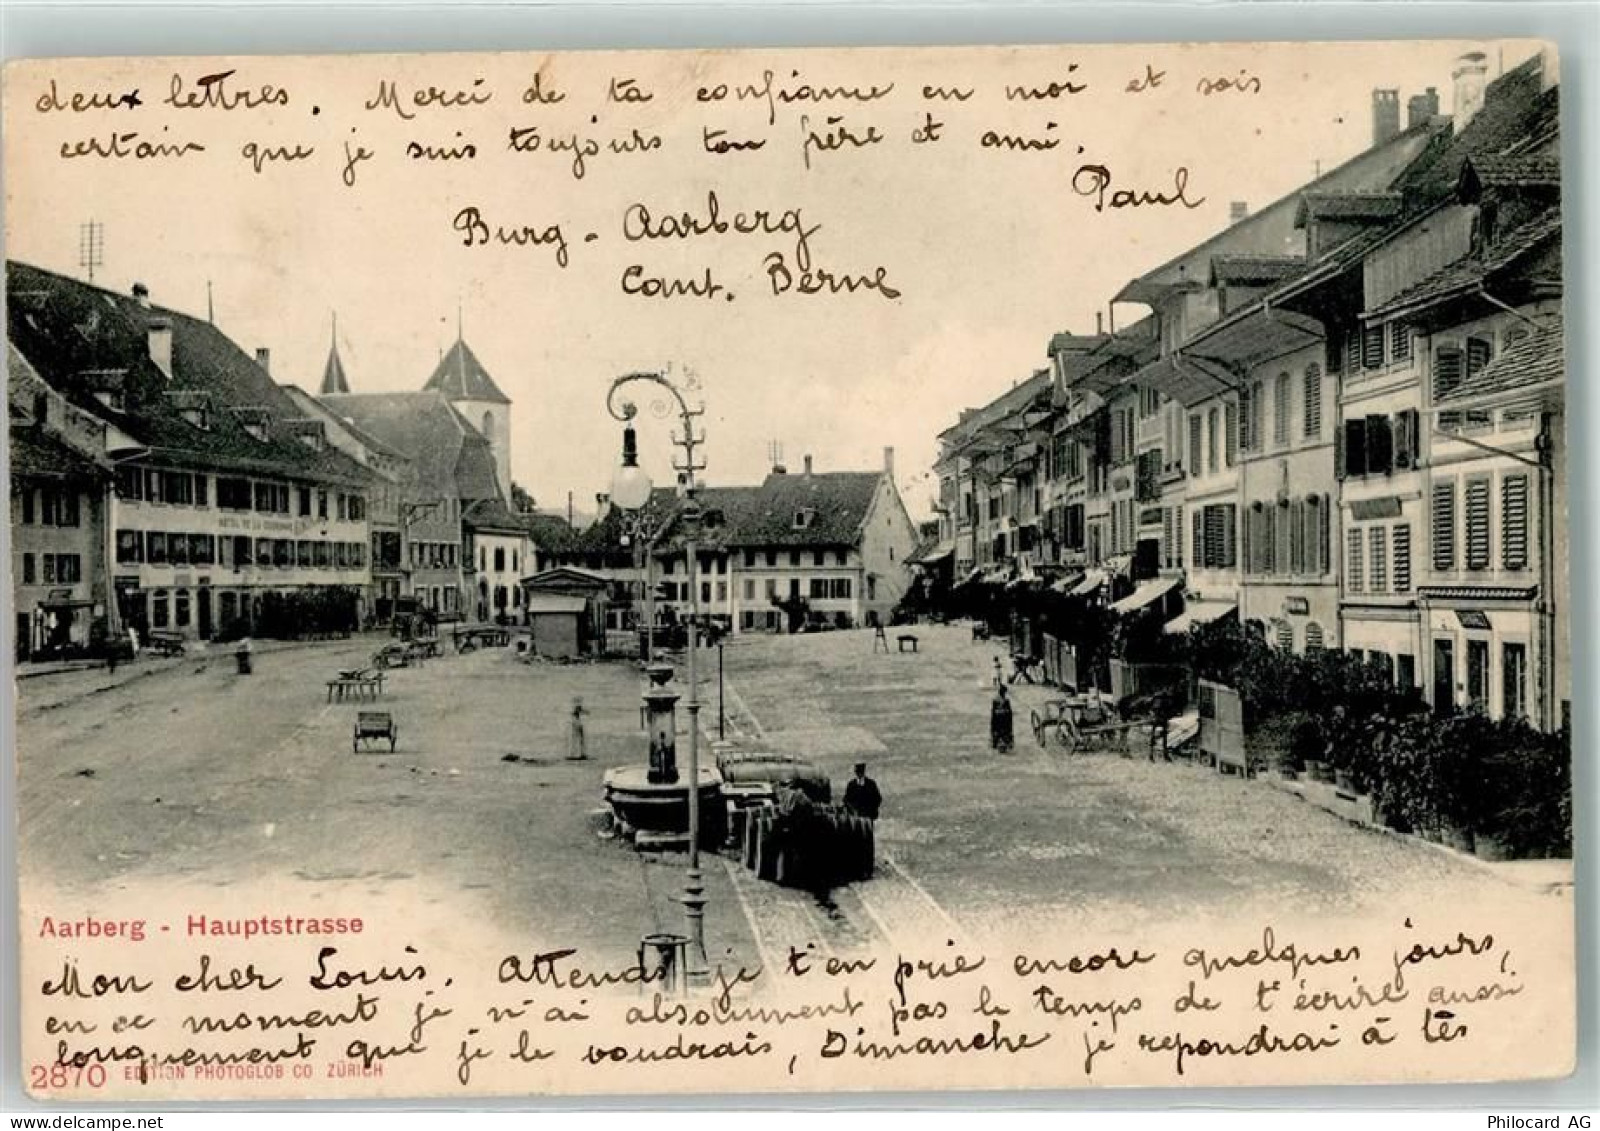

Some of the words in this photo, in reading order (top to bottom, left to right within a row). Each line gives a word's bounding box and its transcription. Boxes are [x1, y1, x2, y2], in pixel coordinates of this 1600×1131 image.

[36, 79, 143, 113] deux
[365, 79, 493, 120] Merci
[523, 72, 566, 104] de
[607, 77, 654, 104] ta
[696, 69, 895, 125] confiance
[922, 84, 975, 101] en
[1004, 64, 1087, 101] moi
[1125, 64, 1167, 93] et
[1196, 69, 1261, 96] sois
[60, 124, 206, 159] certain
[242, 141, 315, 174] que
[342, 126, 375, 187] je
[406, 130, 477, 159] suis
[508, 114, 662, 180] toujours
[703, 125, 766, 153] ton
[801, 114, 884, 171] frère
[911, 112, 944, 144] et
[1072, 164, 1206, 212] Paul
[453, 206, 569, 269] Burg
[622, 190, 822, 273] Aarberg
[762, 251, 902, 298] Berne
[39, 915, 147, 942] Aarberg
[187, 914, 364, 940] Hauptstrasse
[41, 954, 154, 998] Mon
[174, 954, 283, 993] cher
[498, 948, 668, 989] Attends
[712, 946, 766, 1014] je
[893, 938, 986, 1007] prie
[1013, 947, 1156, 978] encore
[1183, 926, 1361, 979] quelques
[44, 1014, 98, 1035] en
[182, 993, 380, 1034] moment
[410, 991, 453, 1043] je
[625, 986, 864, 1026] absolument
[889, 997, 948, 1036] pas
[974, 984, 1011, 1016] le
[1033, 984, 1142, 1034] temps
[1174, 981, 1222, 1014] de
[1427, 970, 1525, 1006] aussi
[29, 1063, 108, 1090] 2870
[194, 1063, 285, 1080] PHOTOGLOB
[292, 1063, 313, 1080] CO
[326, 1060, 385, 1079] ZÜRICH
[346, 1038, 428, 1069] que
[456, 1028, 495, 1086] je
[509, 1029, 556, 1063] le
[820, 1019, 1052, 1060] Dimanche
[1082, 1020, 1116, 1076] je
